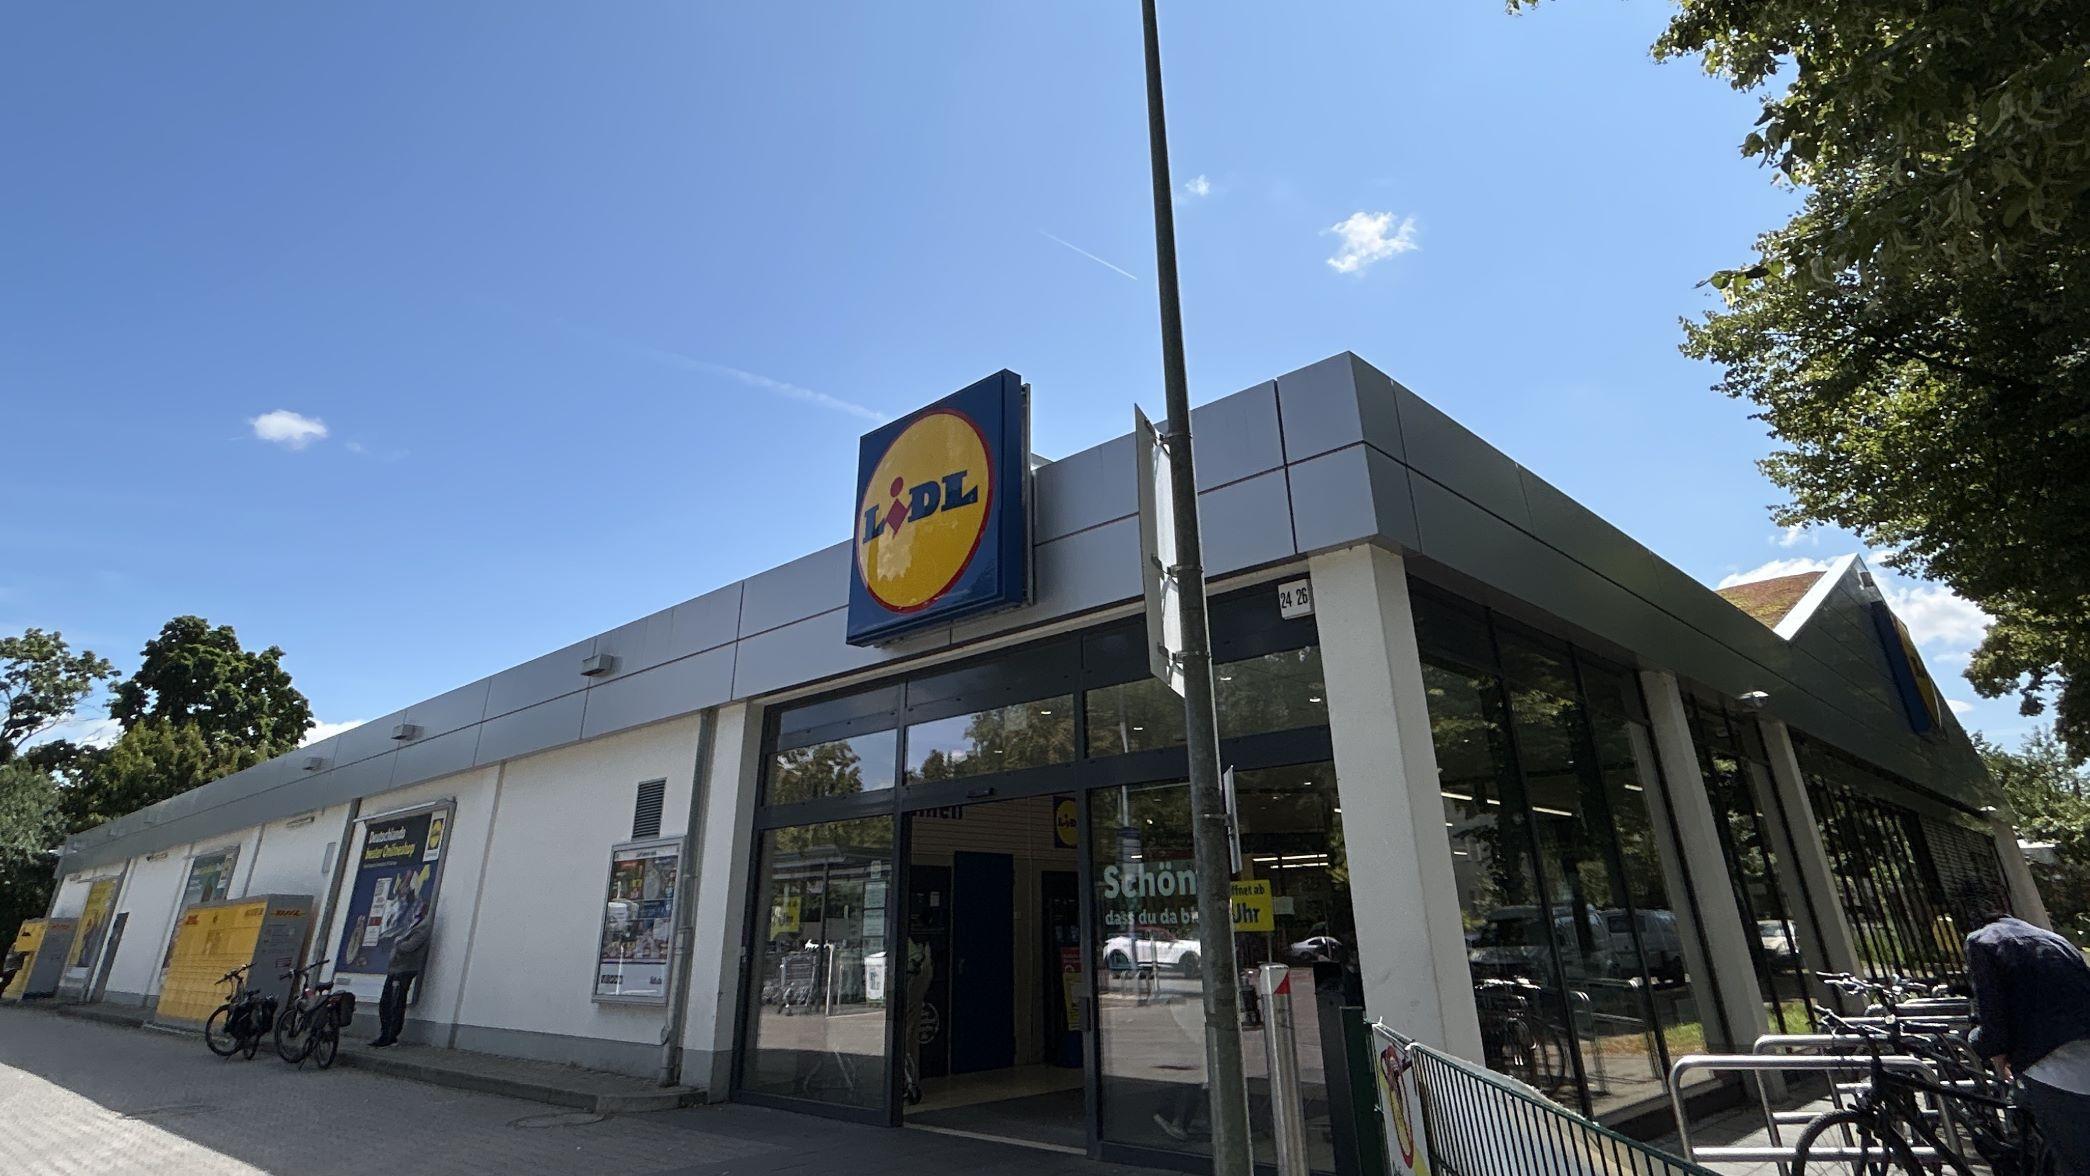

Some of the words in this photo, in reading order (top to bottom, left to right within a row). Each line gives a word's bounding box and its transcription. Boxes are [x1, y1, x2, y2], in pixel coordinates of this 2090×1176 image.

[1280, 591, 1292, 608] 24
[1296, 587, 1308, 605] 26
[1253, 883, 1265, 896] ab
[1105, 909, 1136, 926] dass
[1138, 909, 1157, 925] du
[1160, 908, 1178, 925] da
